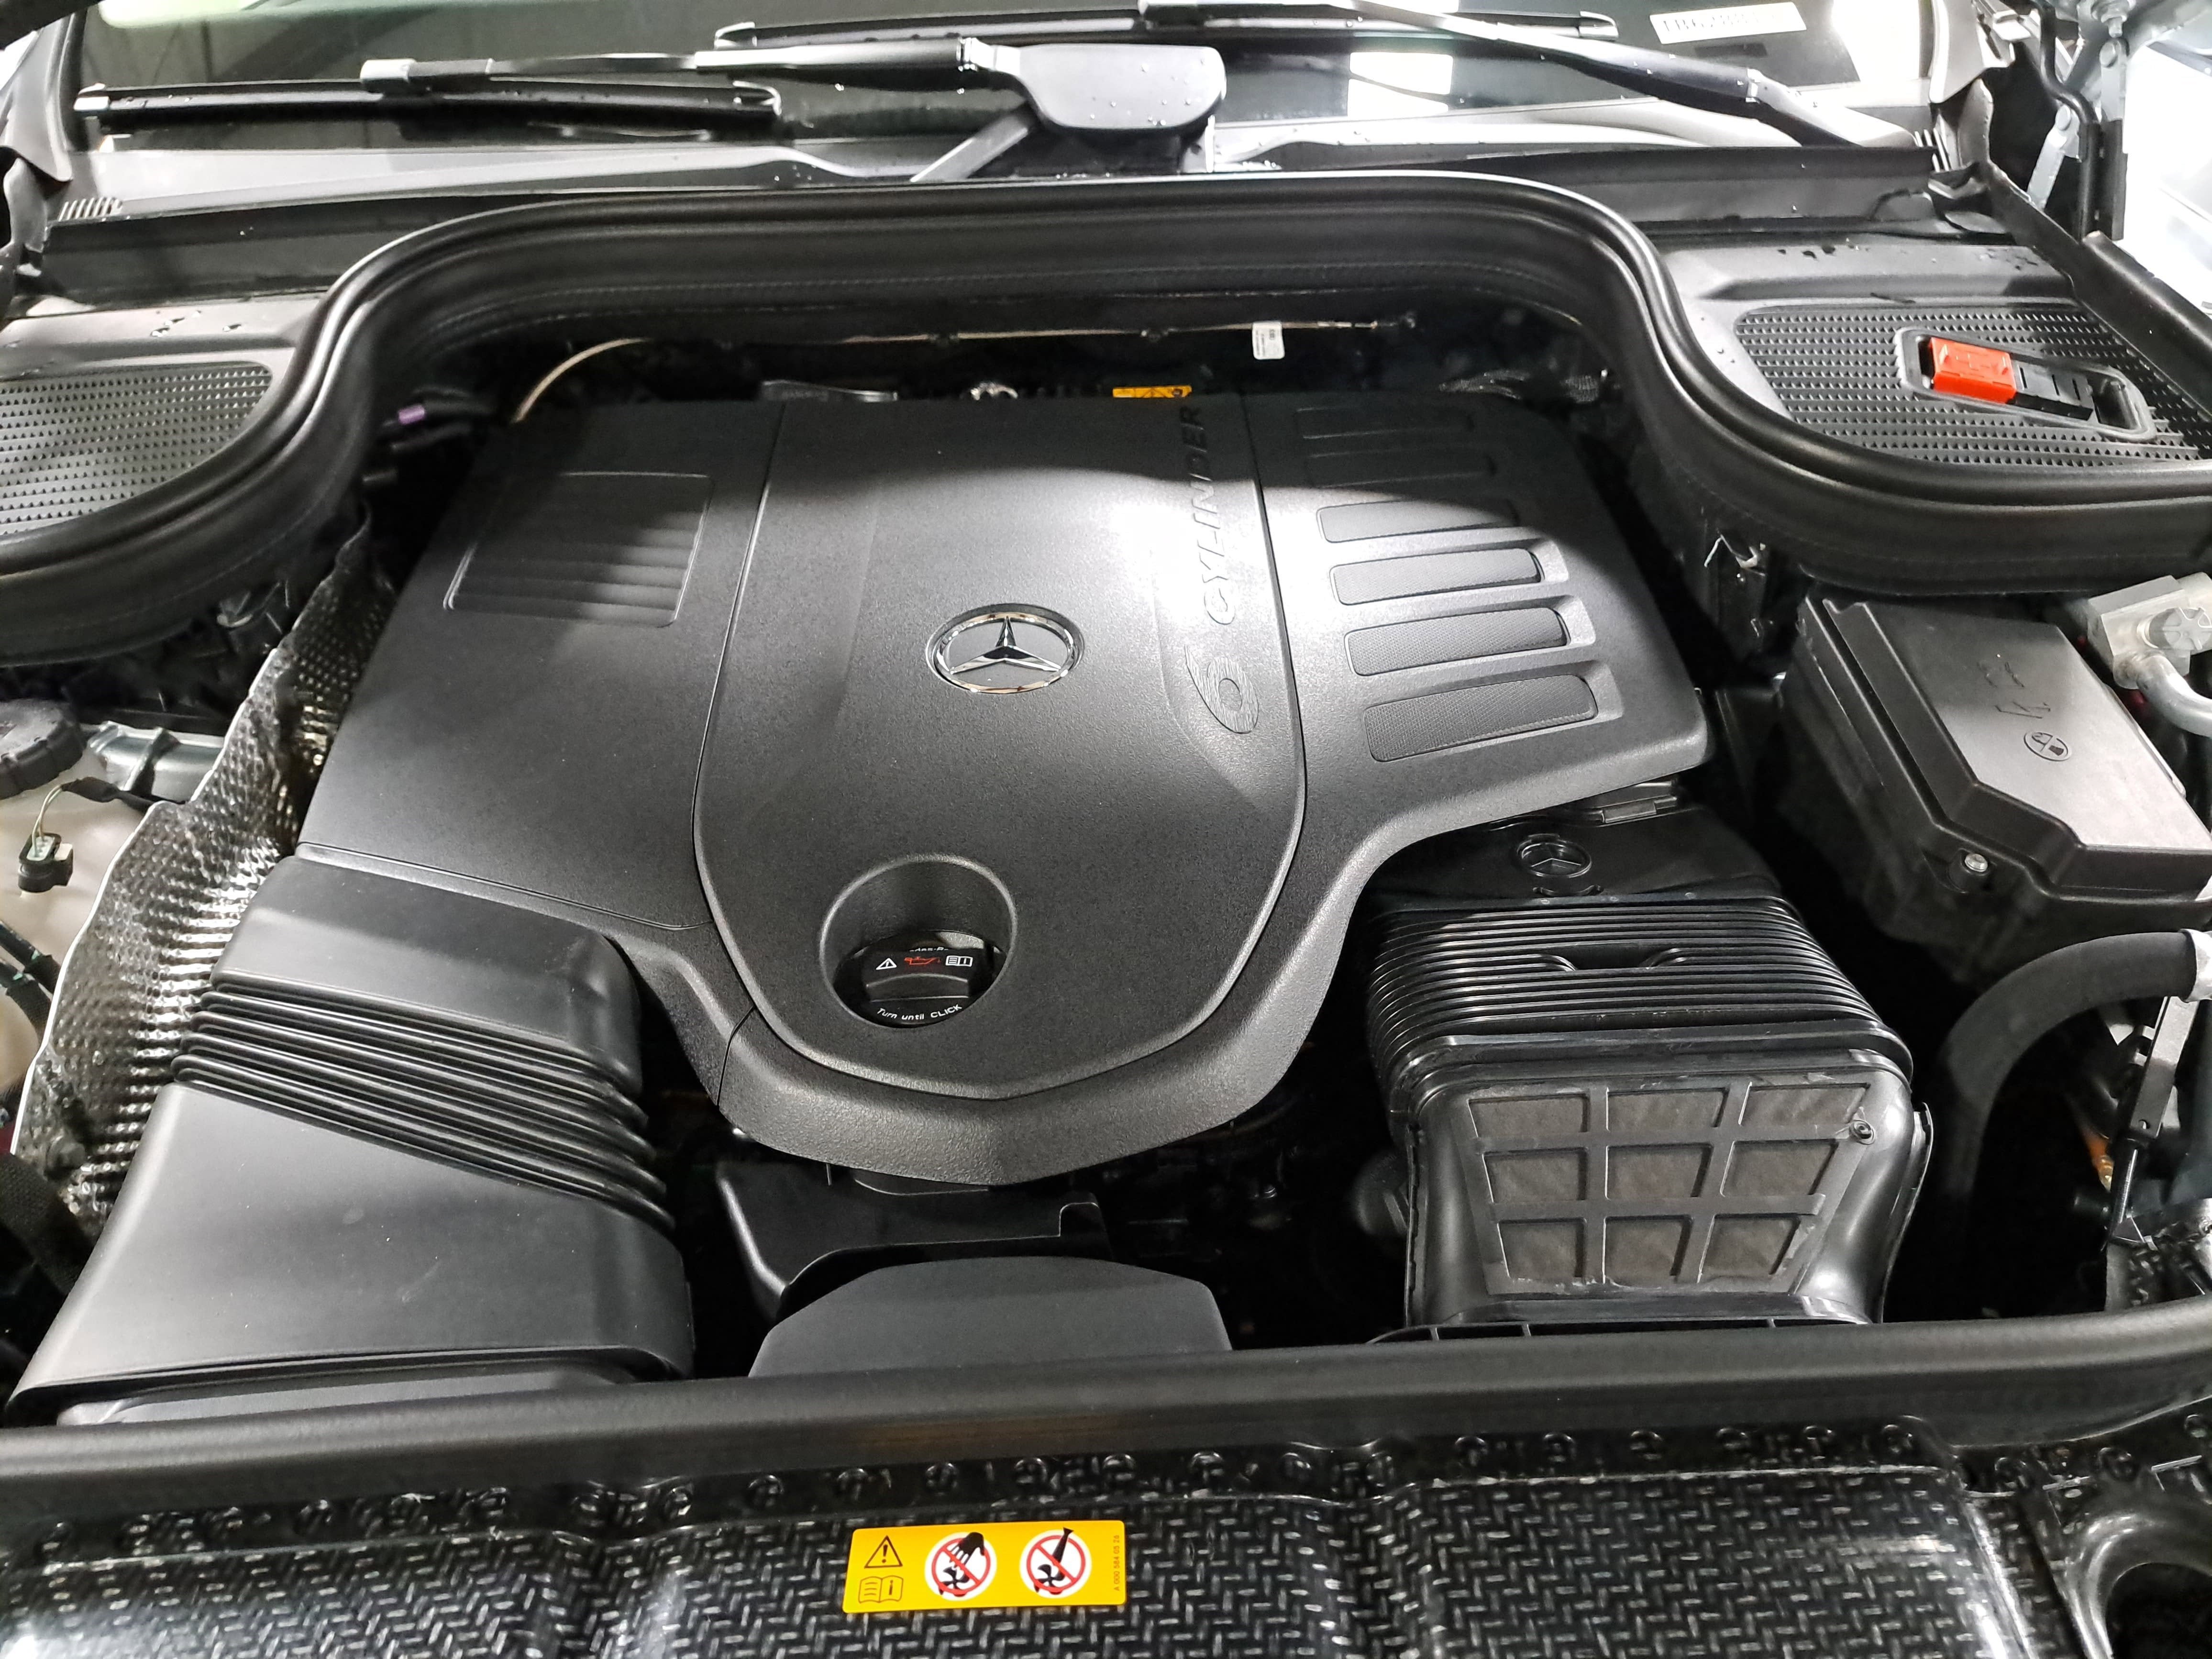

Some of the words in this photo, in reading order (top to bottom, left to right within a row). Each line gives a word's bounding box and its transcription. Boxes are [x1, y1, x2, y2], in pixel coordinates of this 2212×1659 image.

[1179, 406, 1236, 626] CYLINDER
[1184, 644, 1259, 735] 6
[877, 1007, 898, 1019] Turn
[930, 1004, 962, 1018] CLICK
